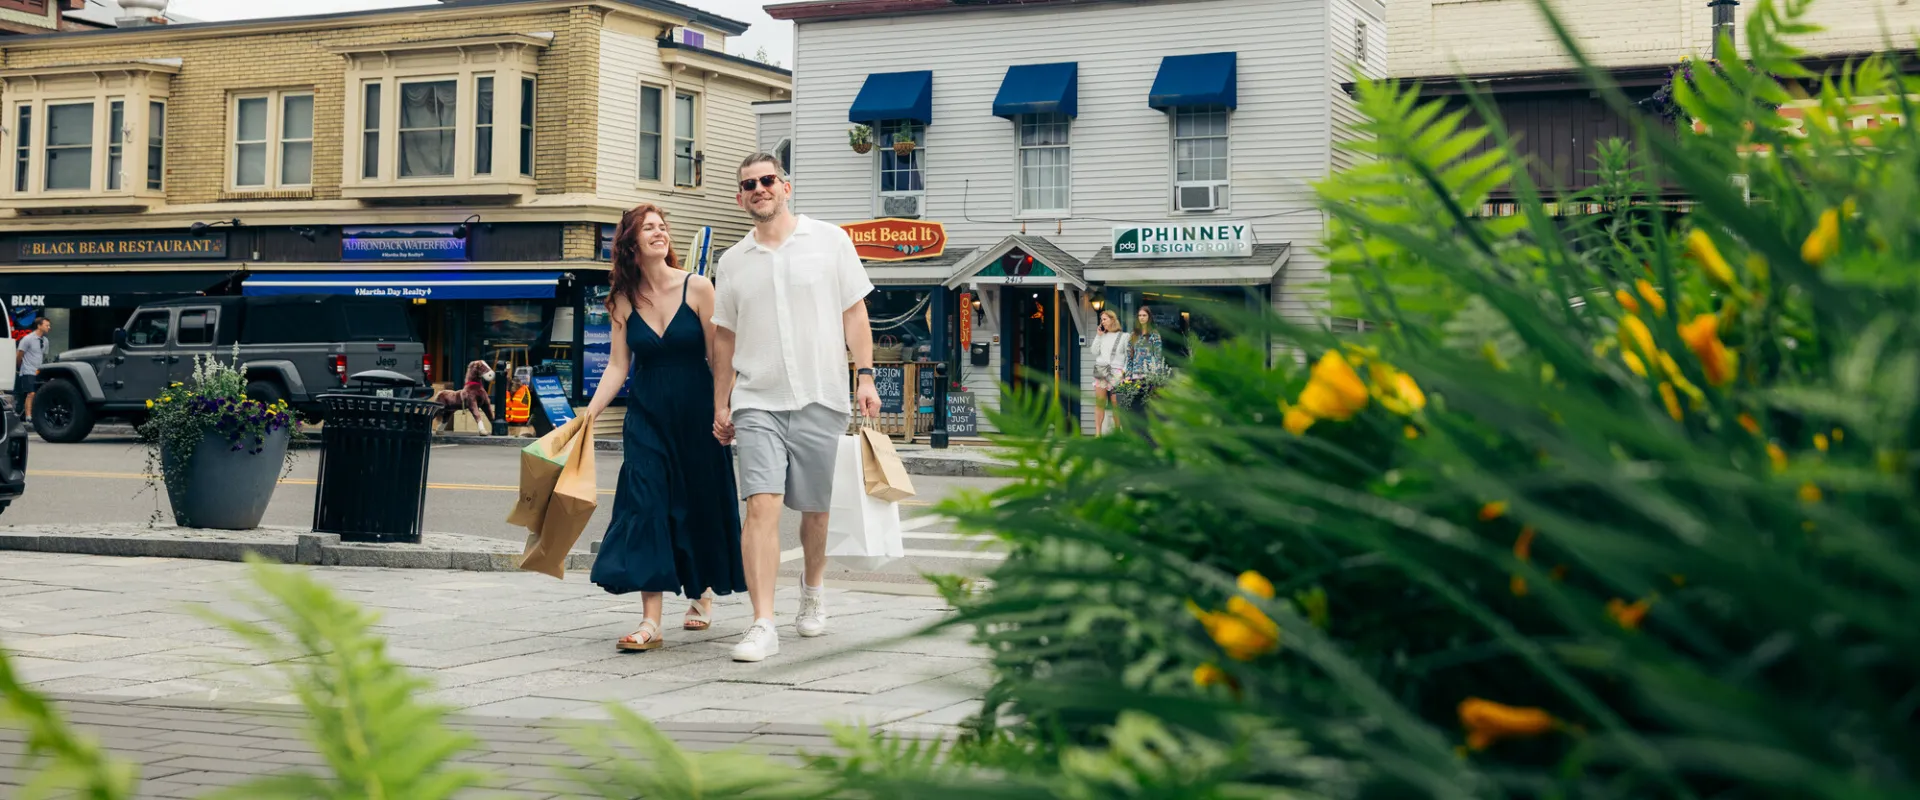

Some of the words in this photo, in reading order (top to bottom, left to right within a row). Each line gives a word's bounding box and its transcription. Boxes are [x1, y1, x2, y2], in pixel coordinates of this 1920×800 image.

[849, 227, 876, 242] Just
[880, 226, 917, 241] Bead
[920, 226, 932, 241] It
[1142, 225, 1245, 241] PHINNEY
[32, 242, 75, 254] BLACK
[79, 241, 115, 254] BEAR
[119, 239, 211, 253] RESTAURANT
[344, 240, 403, 251] ADIRONDACK
[404, 239, 466, 250] WATERFRONT
[1119, 241, 1136, 252] pdg
[1009, 254, 1025, 277] 7
[359, 287, 386, 296] Martha
[387, 287, 402, 297] Day
[403, 287, 427, 297] Realty
[11, 295, 45, 306] BLACK
[81, 295, 110, 306] BEAR
[961, 297, 970, 342] OPEN
[376, 356, 397, 367] Jeep
[874, 367, 900, 378] DESIGN
[876, 382, 900, 391] CREATE
[948, 395, 970, 404] RAINY
[950, 405, 966, 413] DAY
[950, 415, 969, 423] JUST
[946, 424, 965, 432] BEAD
[966, 423, 974, 432] IT
